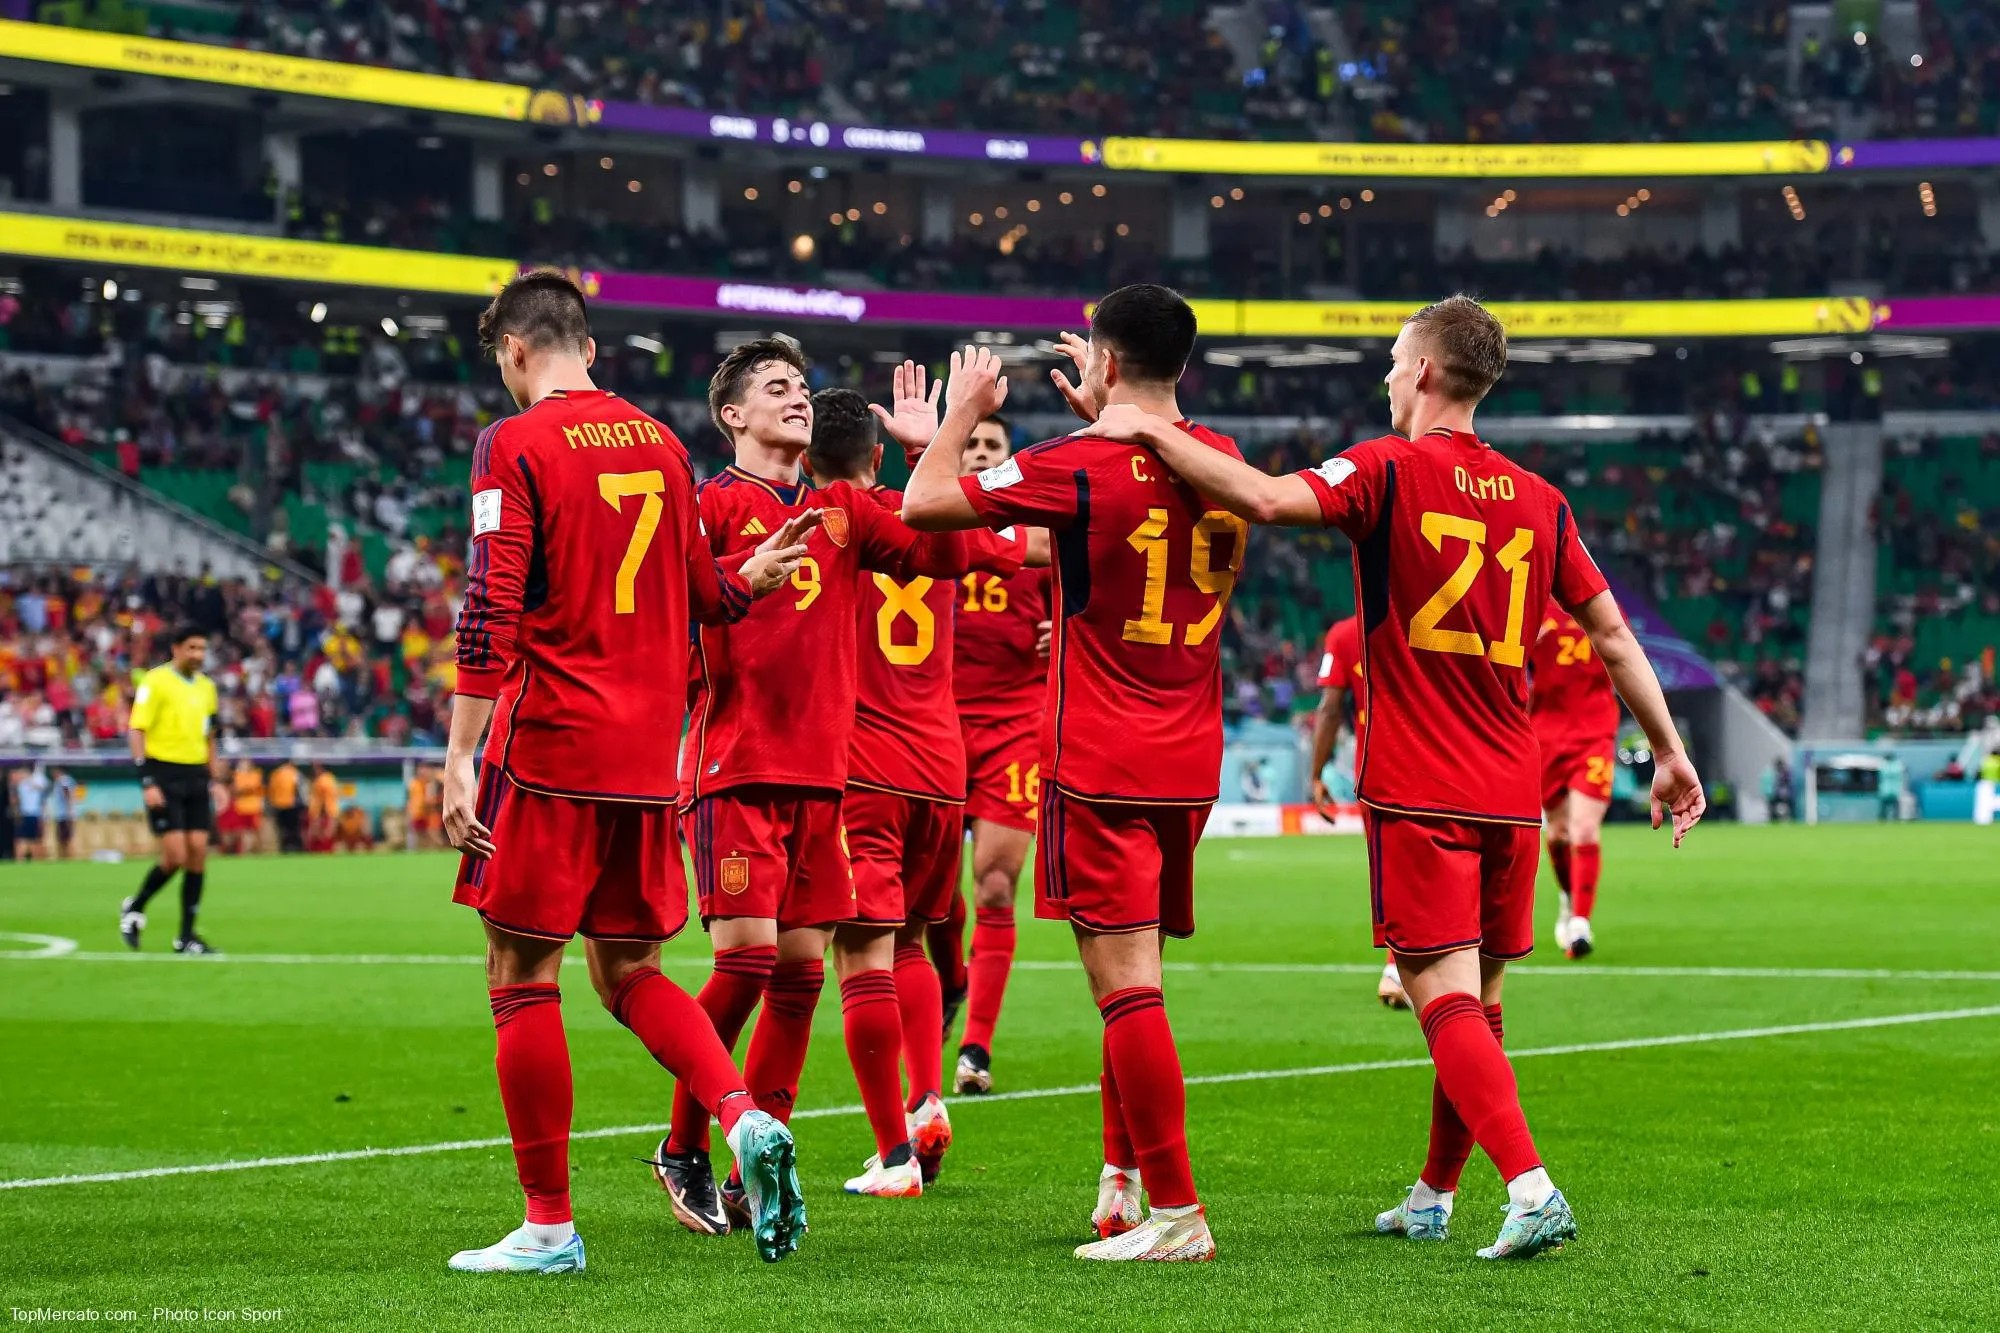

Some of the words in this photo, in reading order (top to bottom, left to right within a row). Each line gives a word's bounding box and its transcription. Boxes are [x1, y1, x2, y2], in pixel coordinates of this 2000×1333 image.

[562, 420, 664, 449] MORATA
[1454, 466, 1515, 500] OLMO
[598, 470, 665, 614] 7
[790, 557, 821, 611] 9
[962, 572, 1008, 612] 16
[1122, 509, 1248, 645] 19
[1409, 512, 1534, 668] 21
[872, 572, 934, 665] 8
[1556, 636, 1592, 665] 24
[1005, 760, 1040, 804] 16
